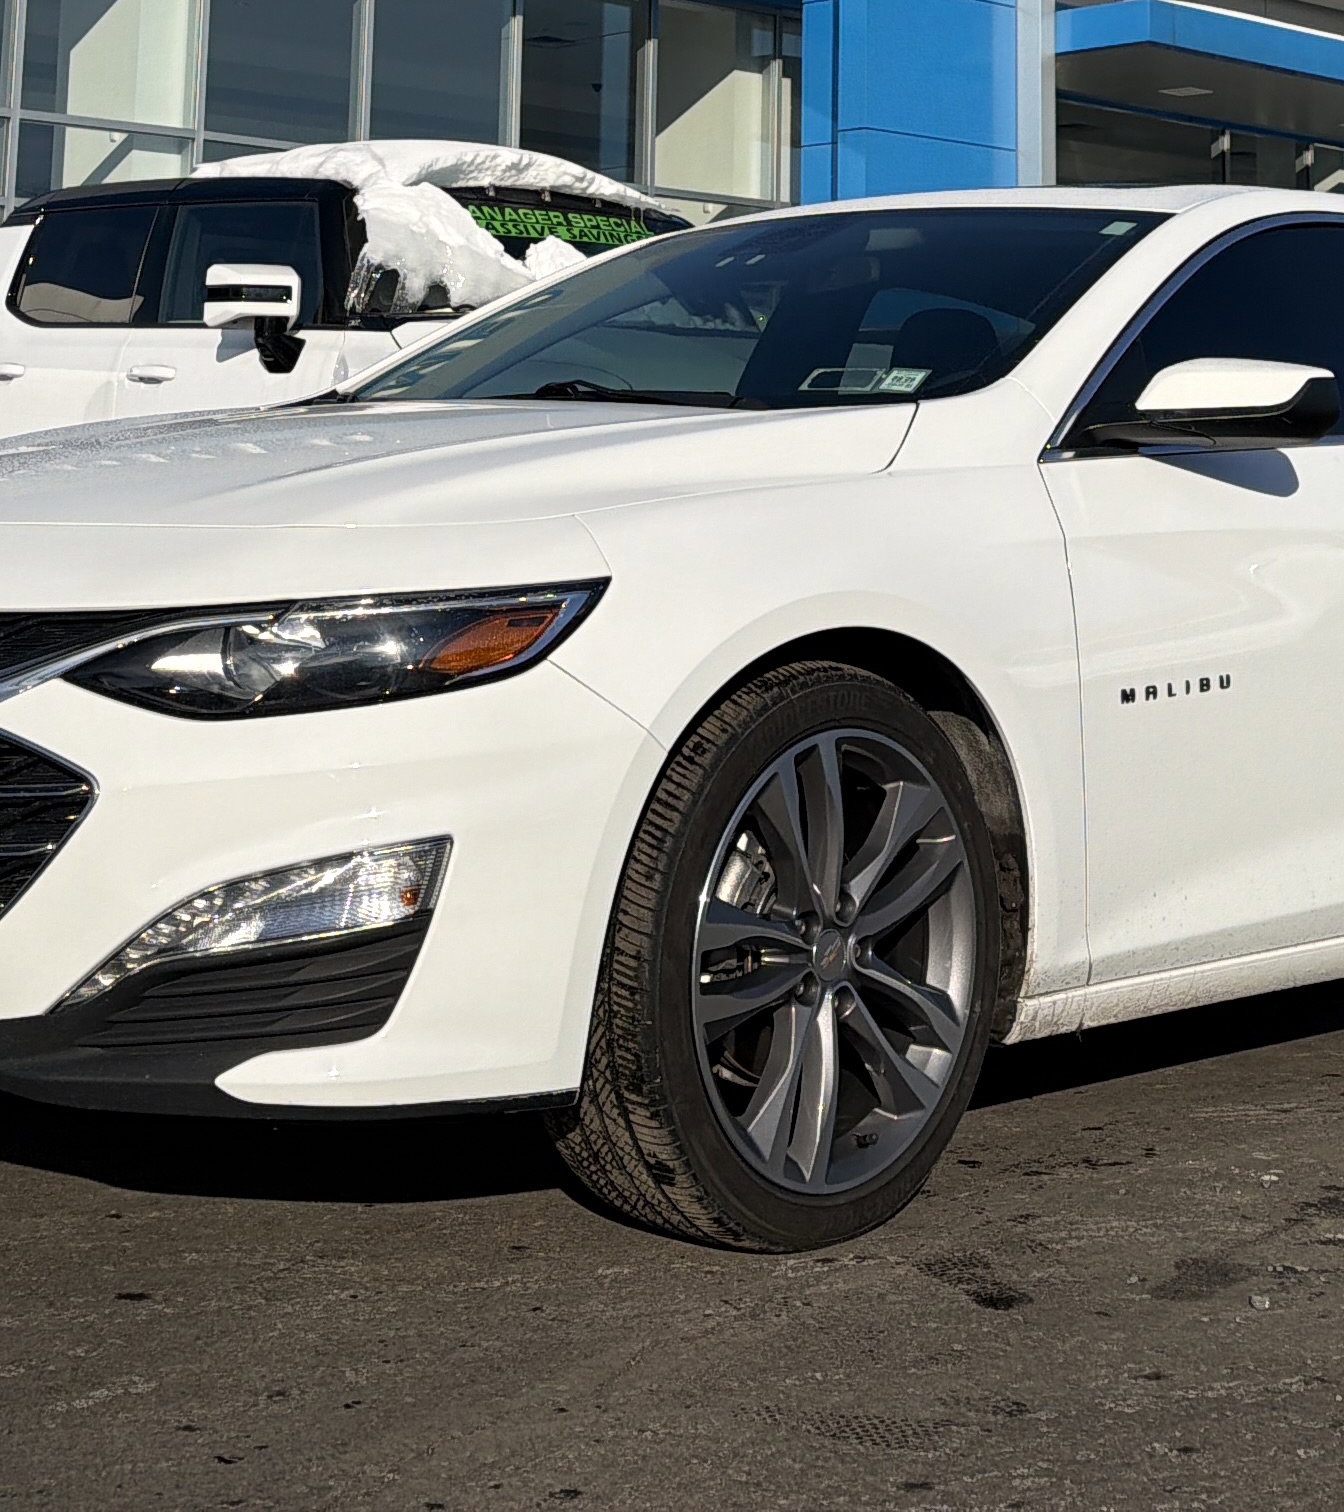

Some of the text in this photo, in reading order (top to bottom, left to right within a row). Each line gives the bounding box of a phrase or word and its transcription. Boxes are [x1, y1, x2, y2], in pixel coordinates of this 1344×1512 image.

[467, 204, 655, 236] ANAGER SPECIAL
[482, 221, 559, 236] ASSIVE
[1120, 673, 1232, 705] MALIBU
